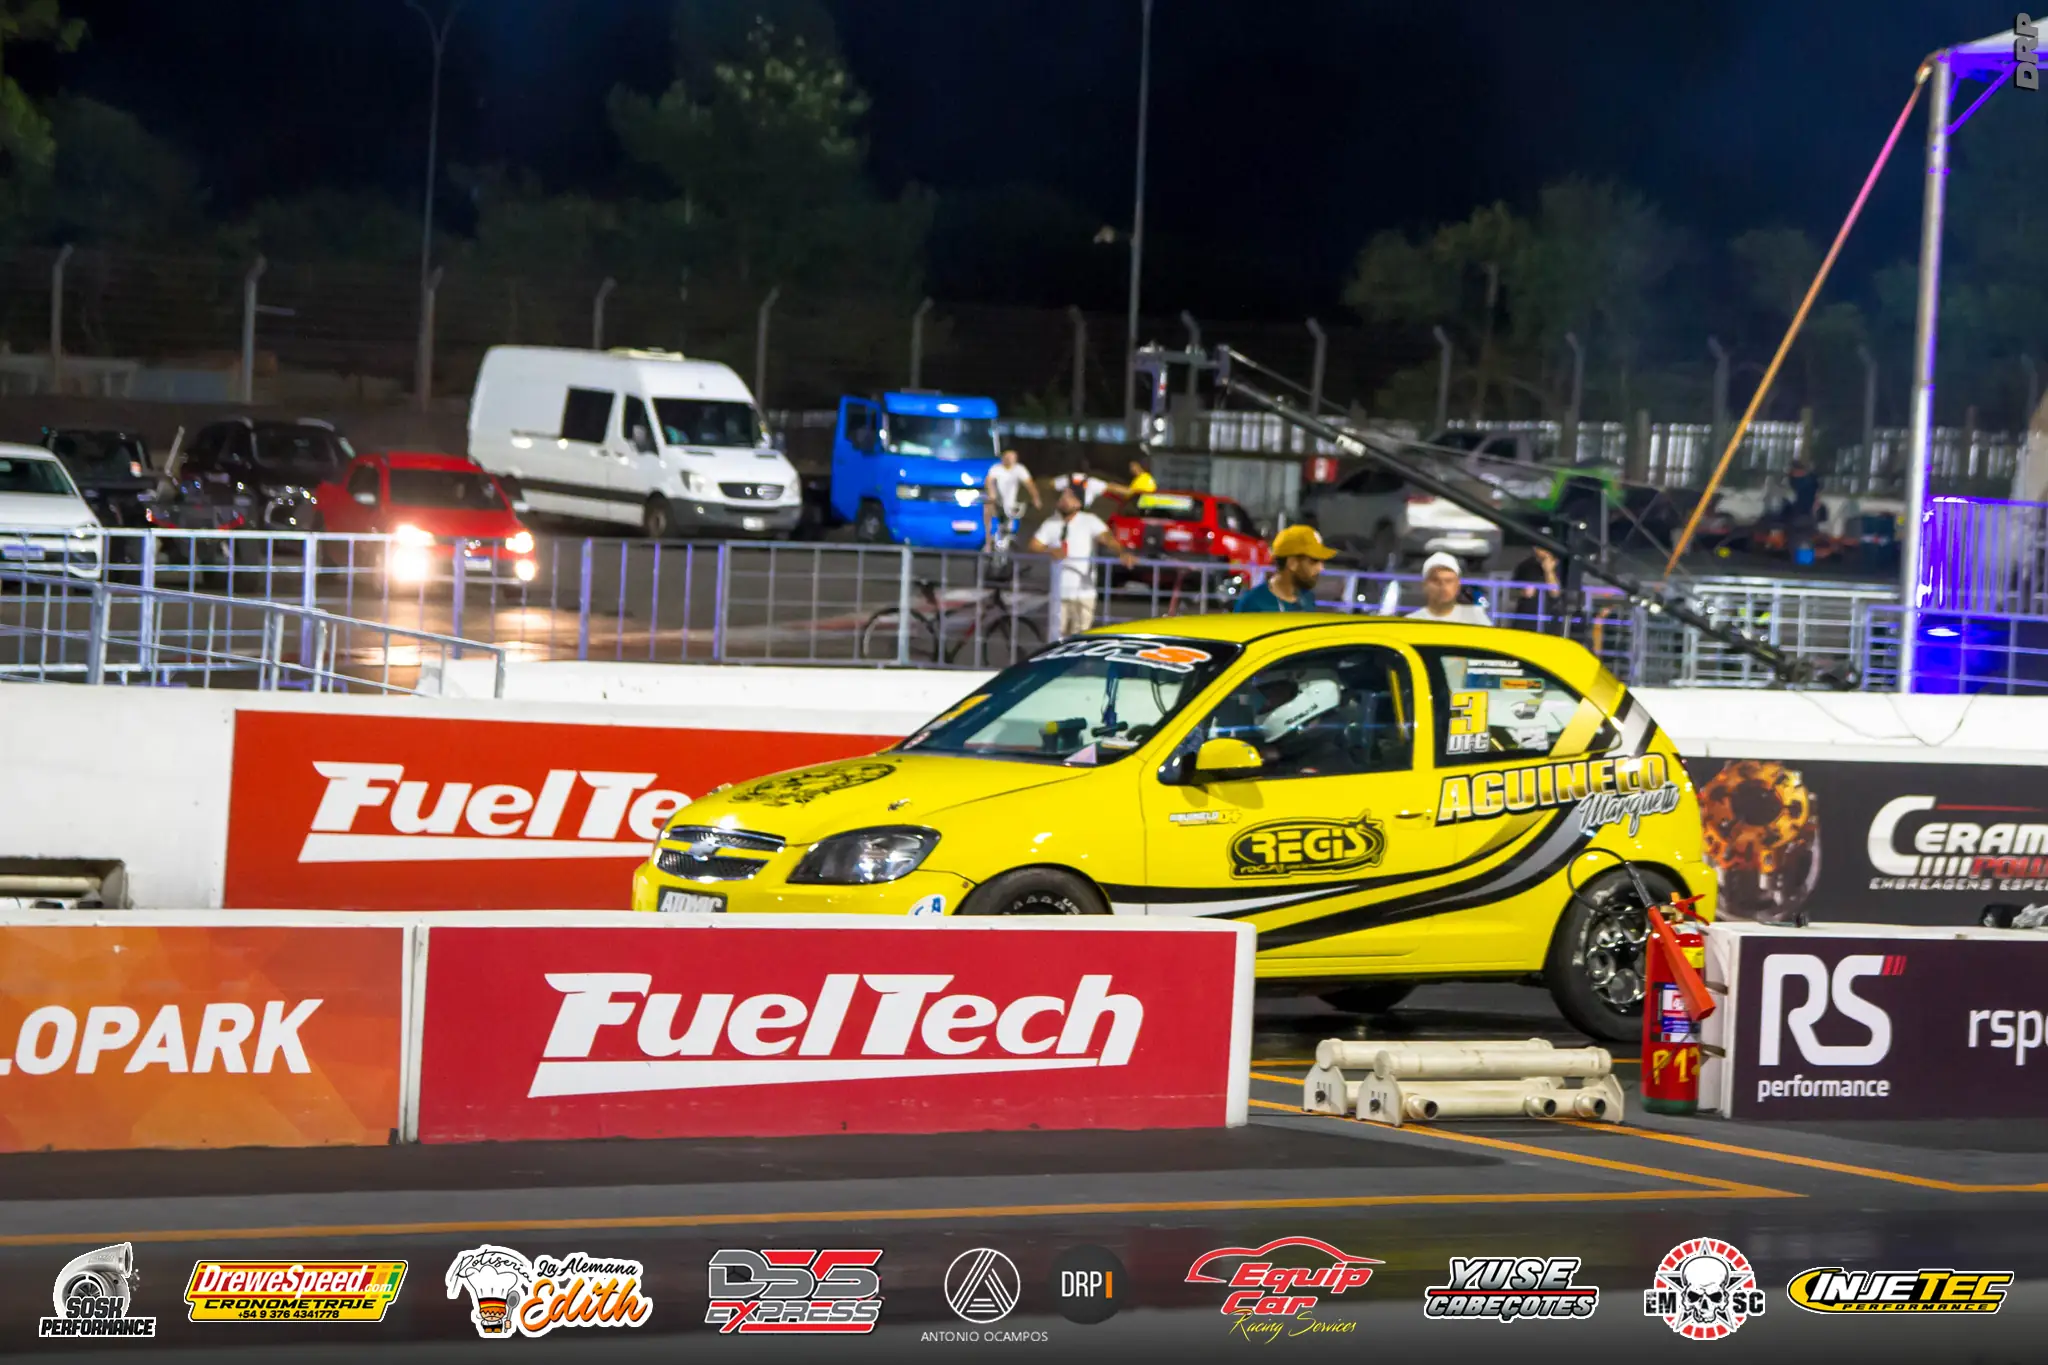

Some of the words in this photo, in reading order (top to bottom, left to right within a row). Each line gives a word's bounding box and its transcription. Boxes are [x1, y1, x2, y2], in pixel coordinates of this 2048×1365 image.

[1450, 691, 1488, 735] 3
[543, 973, 1144, 1066] FuelTech
[1759, 953, 1892, 1066] RS
[1968, 1009, 2048, 1066] rsp
[1757, 1074, 1891, 1102] performance
